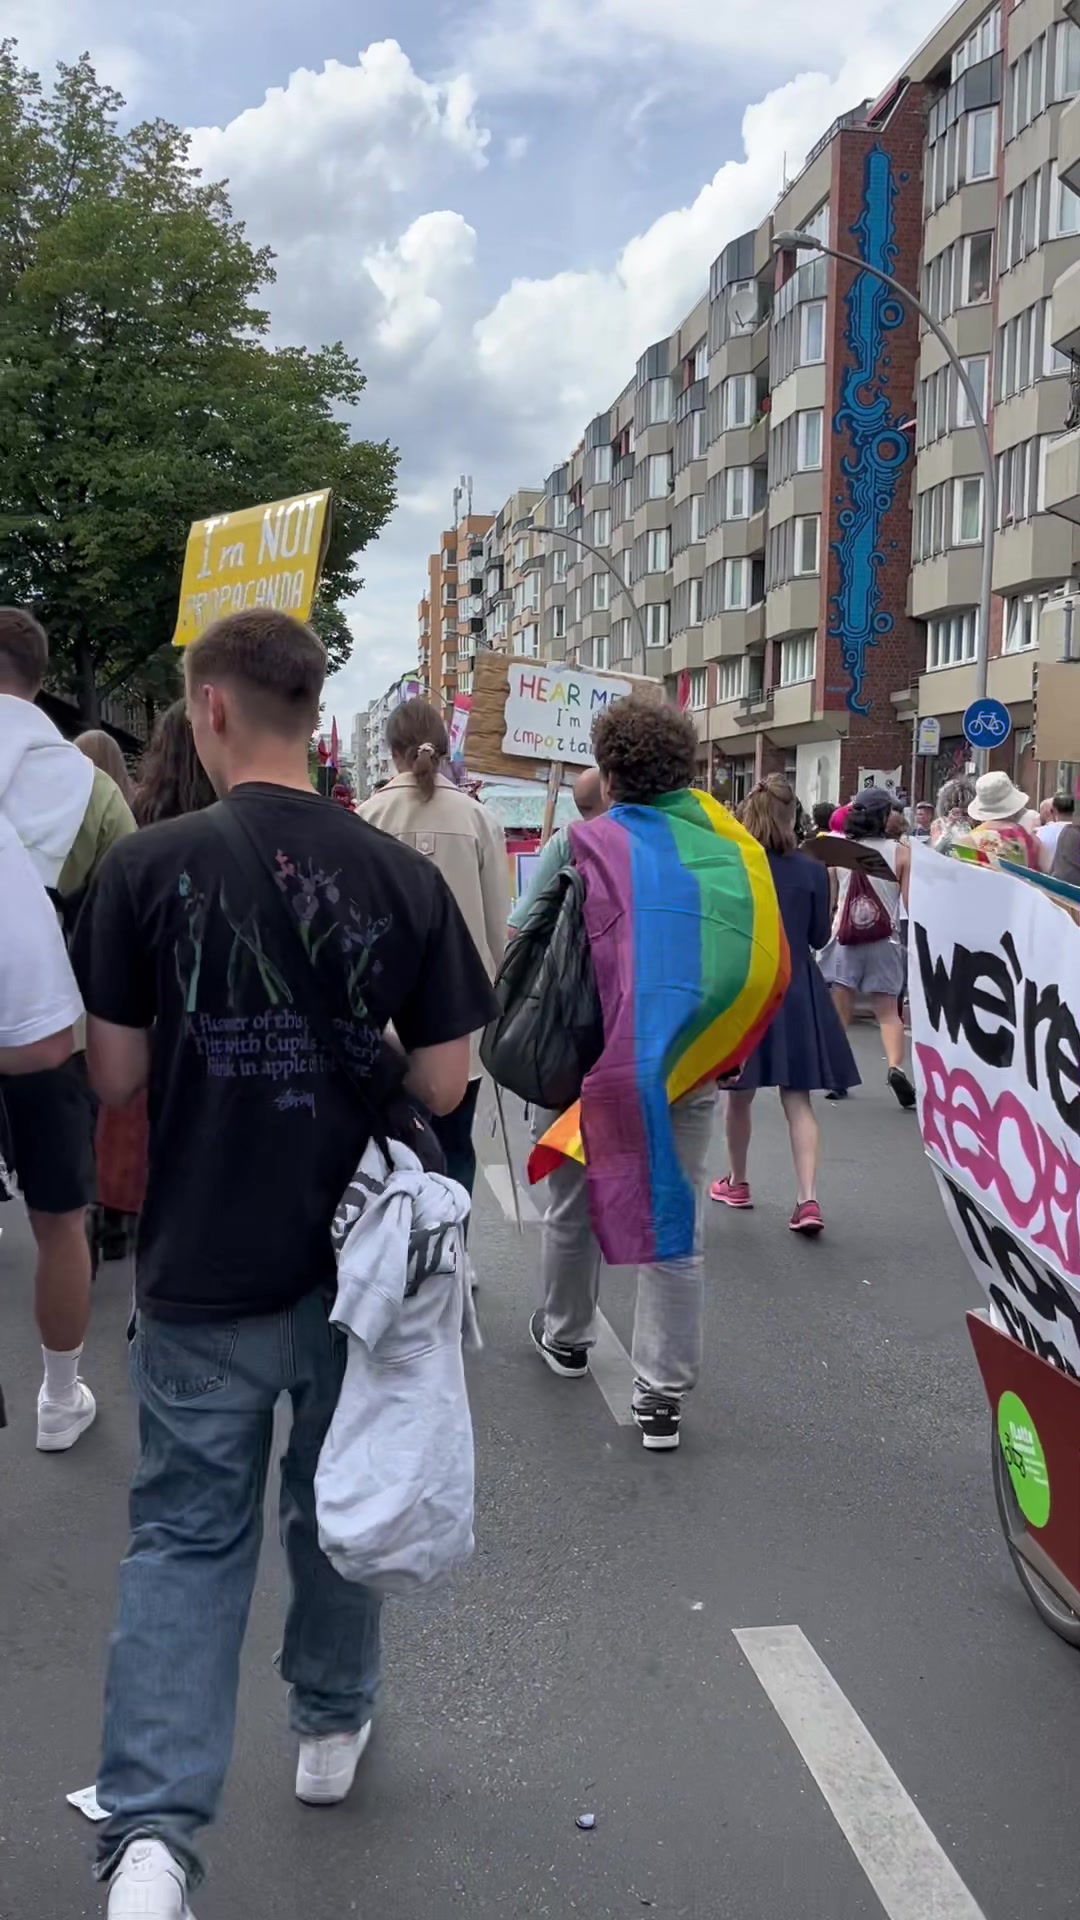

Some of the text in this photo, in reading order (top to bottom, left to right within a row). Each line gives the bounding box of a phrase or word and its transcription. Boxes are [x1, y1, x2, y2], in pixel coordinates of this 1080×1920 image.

[196, 494, 324, 580] I'm NOT
[519, 673, 581, 707] HEAR
[556, 707, 581, 728] I'm
